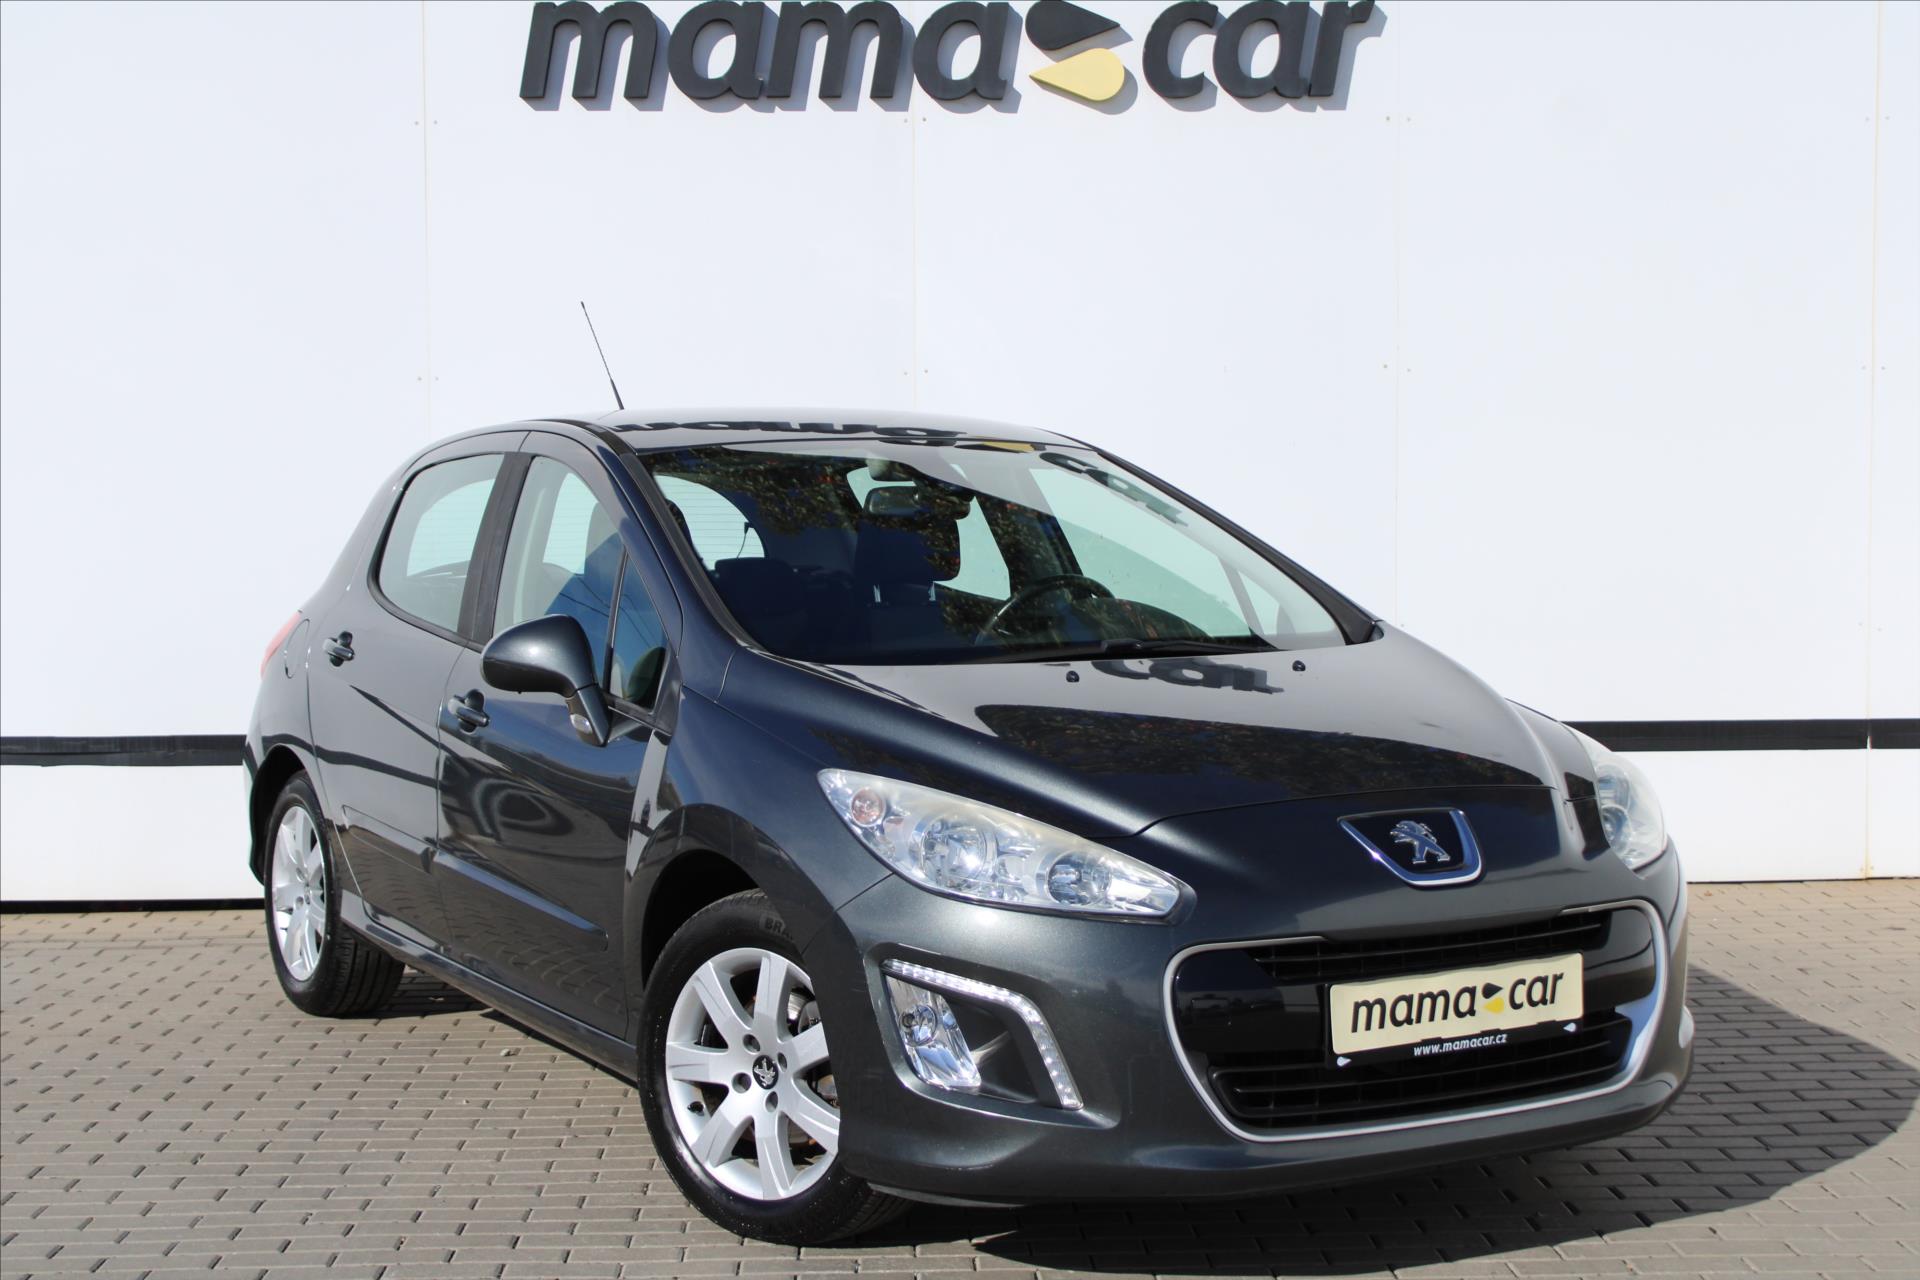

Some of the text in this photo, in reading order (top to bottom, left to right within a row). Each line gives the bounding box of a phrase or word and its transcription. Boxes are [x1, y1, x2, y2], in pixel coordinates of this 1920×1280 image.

[519, 0, 1375, 100] mama car
[1351, 972, 1564, 1033] mama car
[1413, 1033, 1508, 1056] www.mamacar.cz
